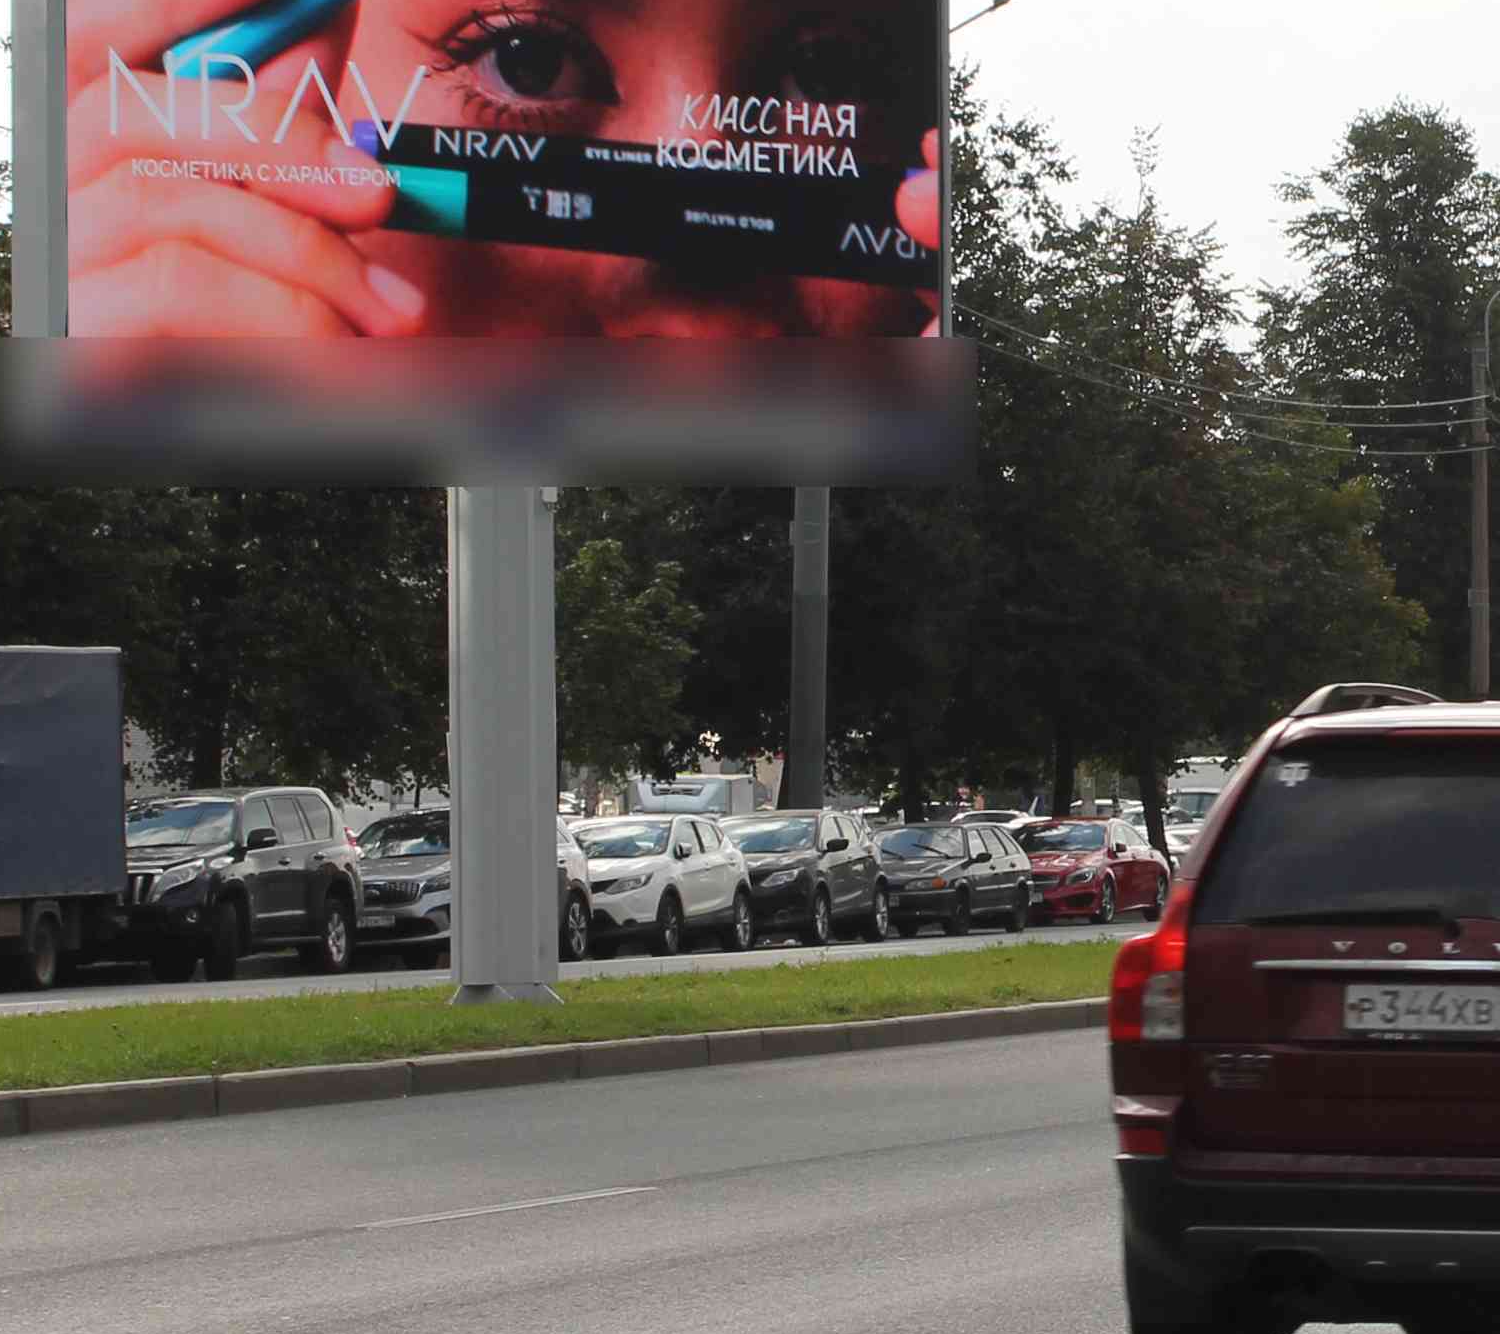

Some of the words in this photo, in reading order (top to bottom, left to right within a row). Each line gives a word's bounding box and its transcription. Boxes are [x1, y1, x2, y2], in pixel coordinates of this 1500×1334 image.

[109, 46, 430, 150] NRAV
[433, 127, 546, 163] NRAV
[656, 137, 860, 178] КОСМЕТИКА
[131, 157, 252, 181] КОСМЕТИКА
[257, 162, 272, 182] С
[274, 163, 402, 188] ХАРАКТЕРОМ
[840, 222, 927, 260] RAV
